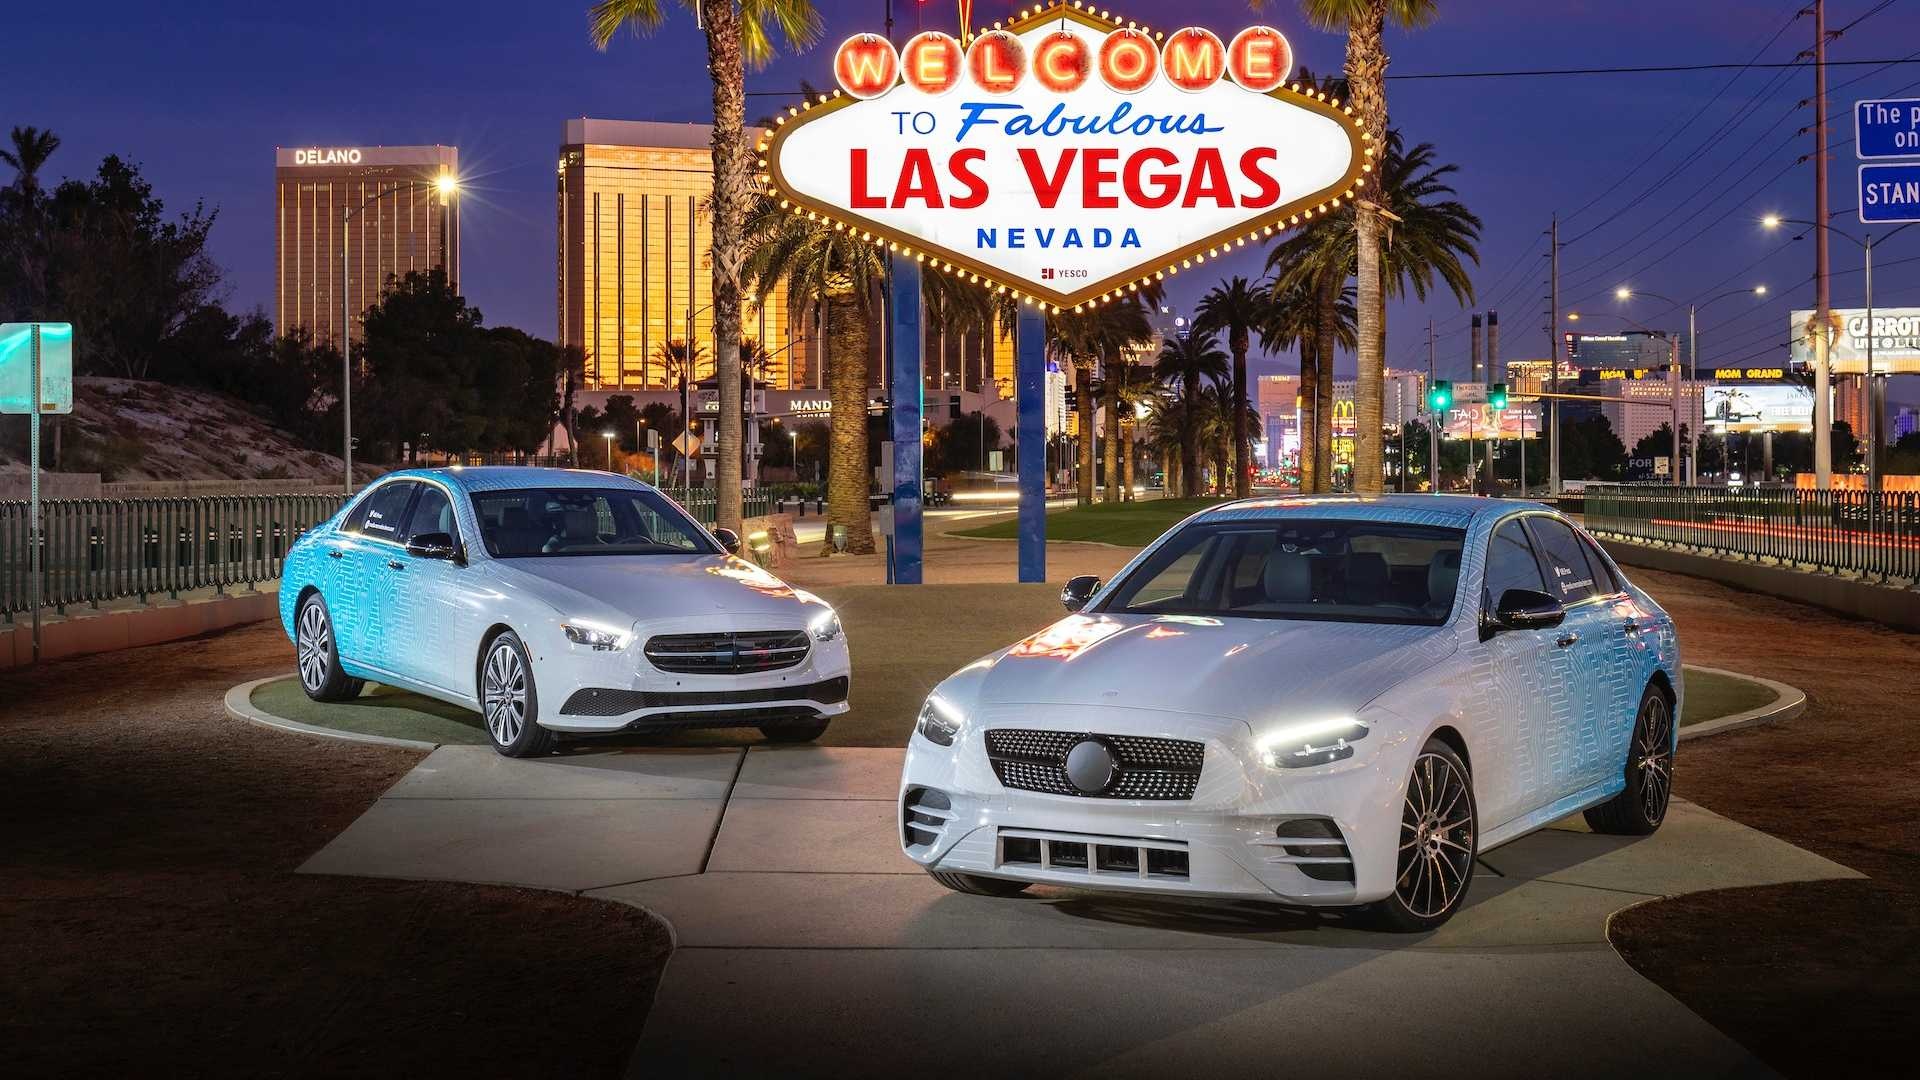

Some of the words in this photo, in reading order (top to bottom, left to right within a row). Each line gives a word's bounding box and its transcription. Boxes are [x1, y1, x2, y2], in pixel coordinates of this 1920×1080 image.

[845, 36, 1286, 90] WELCOME
[891, 111, 936, 135] TO
[955, 101, 1225, 143] Fabulous
[1862, 103, 1901, 125] The
[1894, 130, 1919, 148] on
[295, 149, 362, 164] DELANO
[849, 147, 990, 209] LAS
[1016, 147, 1282, 209] VEGAS
[1865, 181, 1920, 205] STAN
[976, 227, 1142, 249] NEVADA
[1058, 269, 1088, 279] YESCO
[1715, 368, 1742, 379] MGM
[1746, 368, 1784, 379] GRAND
[790, 400, 832, 411] MAND
[1450, 408, 1479, 420] TAO
[1629, 458, 1652, 468] FOR
